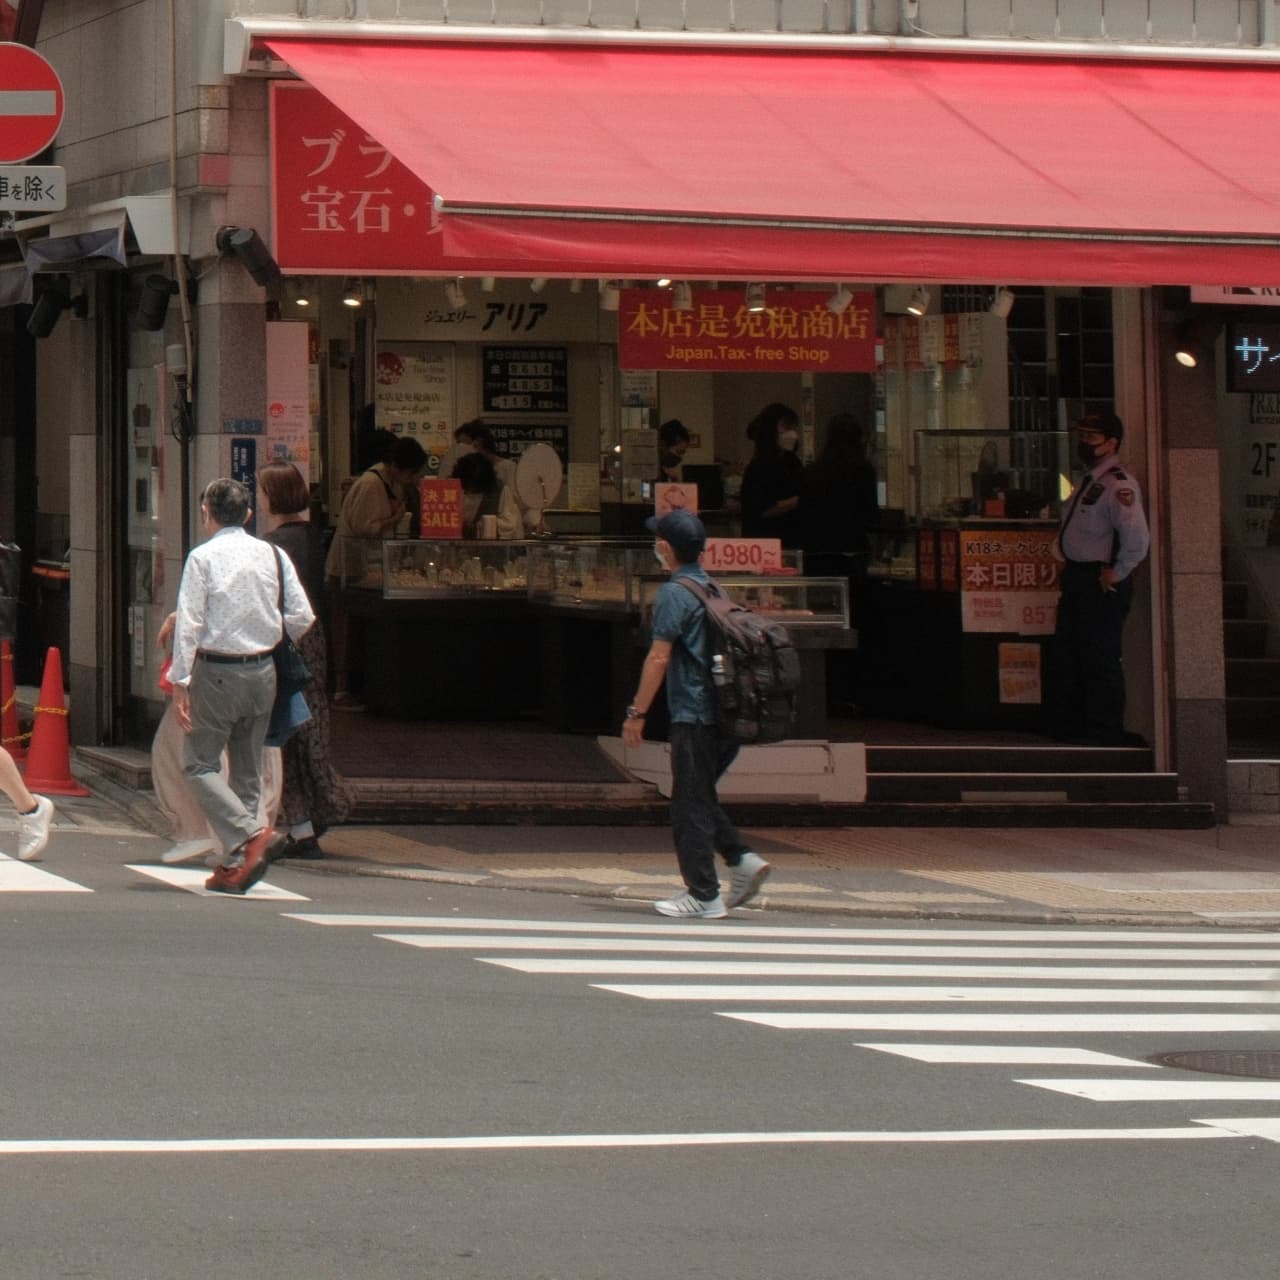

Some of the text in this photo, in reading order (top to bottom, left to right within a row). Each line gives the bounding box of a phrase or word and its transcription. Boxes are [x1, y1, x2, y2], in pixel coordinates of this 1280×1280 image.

[482, 302, 549, 332] アリア
[423, 512, 460, 528] SALE
